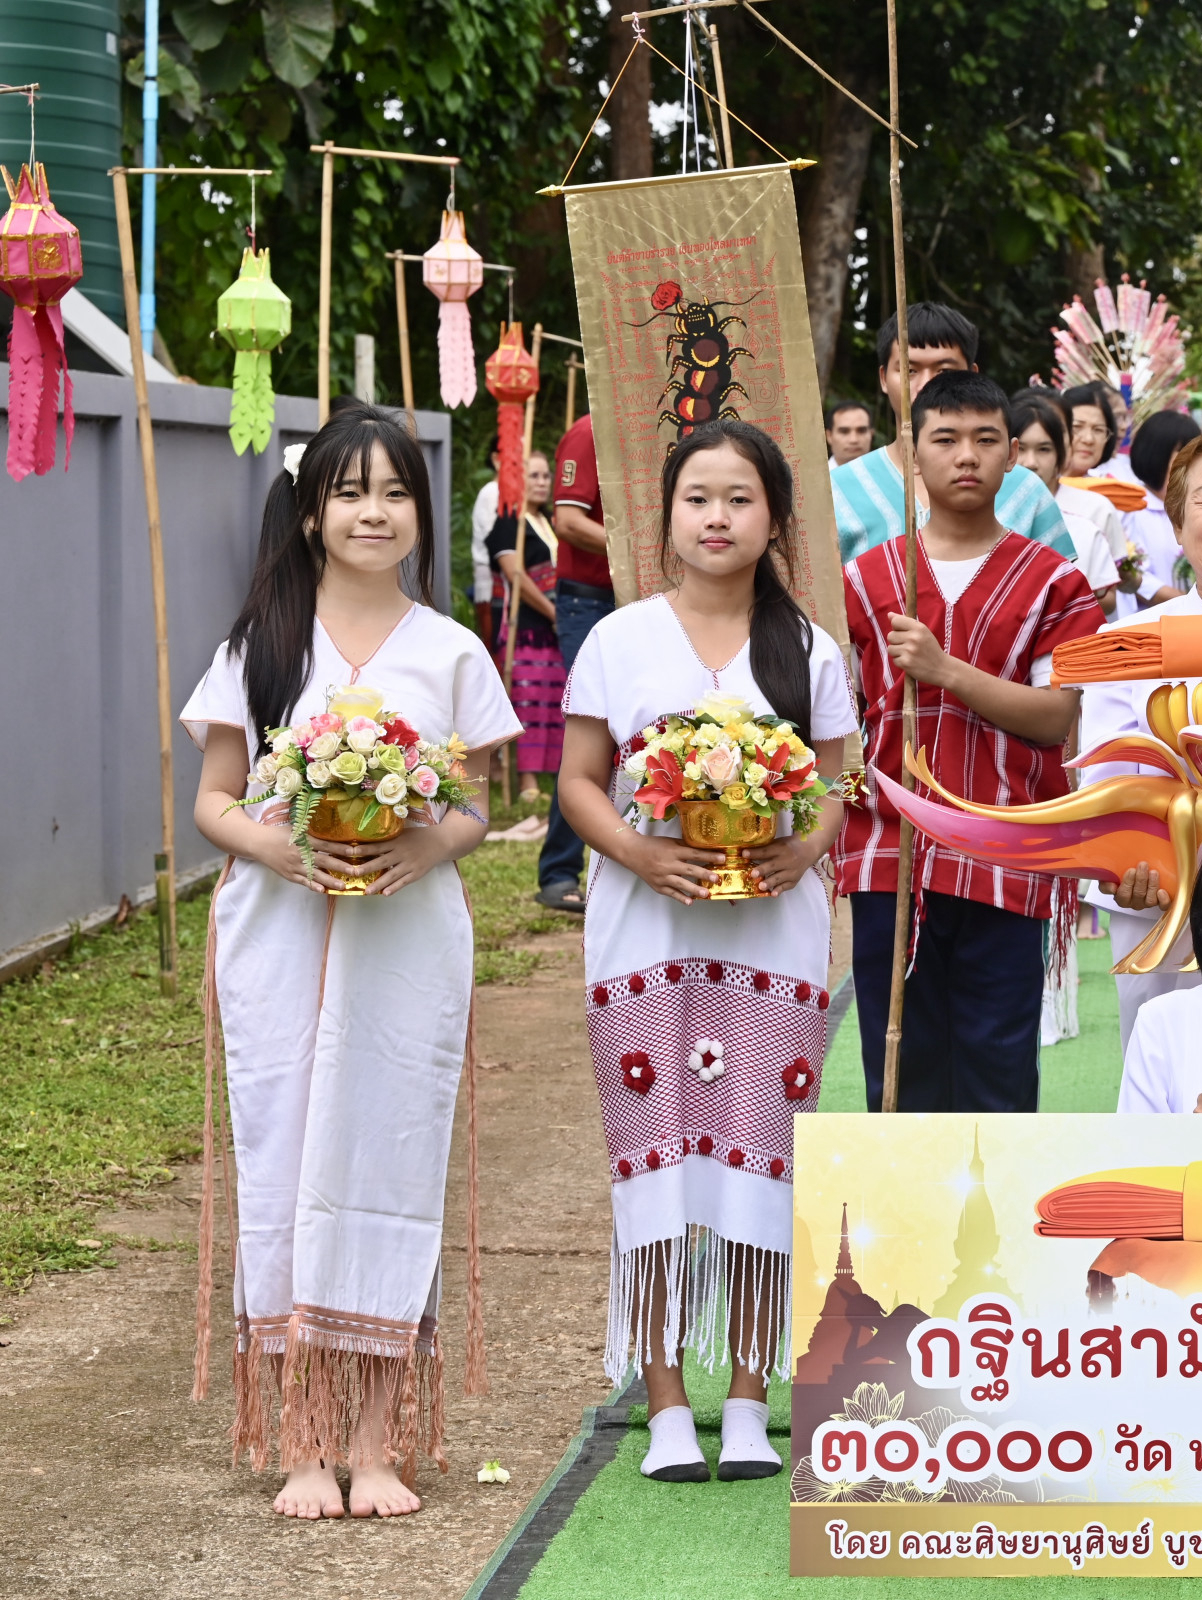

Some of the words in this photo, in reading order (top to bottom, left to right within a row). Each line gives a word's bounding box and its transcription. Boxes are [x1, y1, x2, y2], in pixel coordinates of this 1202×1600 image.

[561, 459, 577, 487] 9
[821, 1430, 1093, 1483] ๓๐,๐๐๐
[1114, 1423, 1172, 1472] วัด
[829, 1523, 889, 1555] โดย
[902, 1521, 1151, 1566] คณะศิษยานุศิษย์
